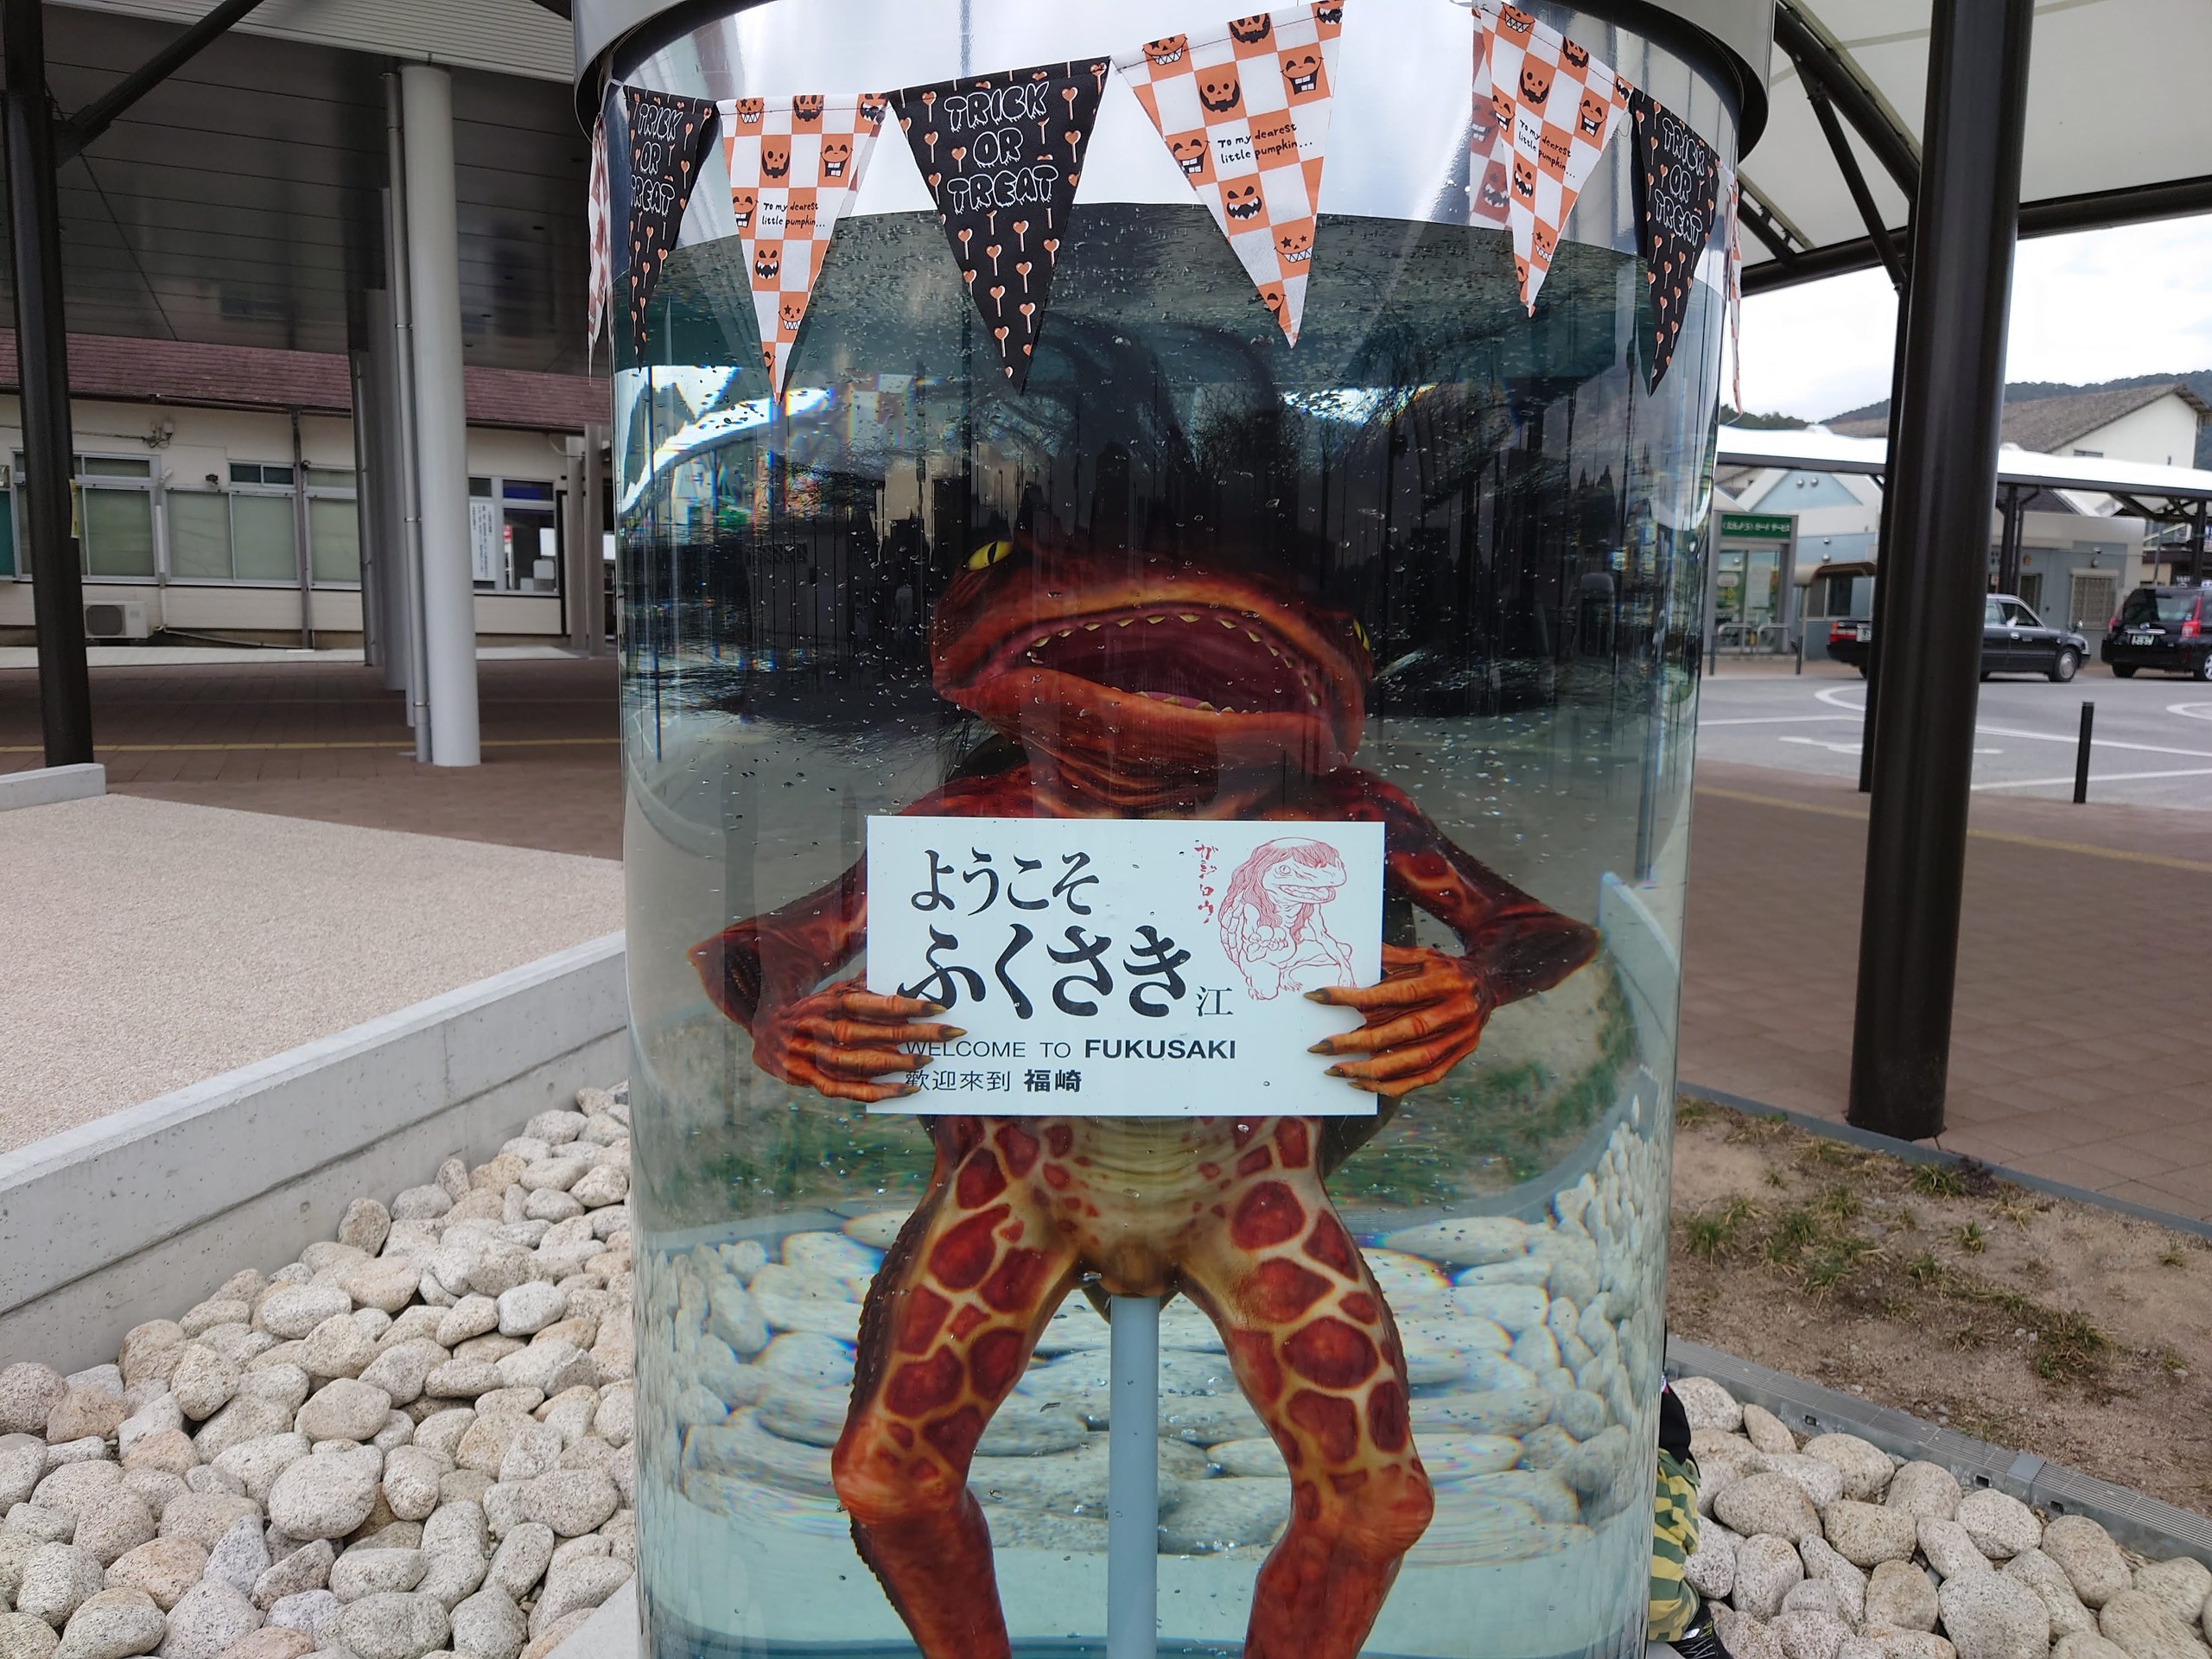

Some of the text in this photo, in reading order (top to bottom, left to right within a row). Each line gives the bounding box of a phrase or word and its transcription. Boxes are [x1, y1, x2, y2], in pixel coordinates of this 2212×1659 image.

[638, 103, 683, 142] TRICK
[944, 81, 1049, 132] TRICK
[973, 127, 1023, 168] OR
[1217, 124, 1297, 149] To my dearest
[1518, 131, 1537, 152] little
[1529, 129, 1541, 140] my
[1541, 136, 1571, 157] dearest
[1662, 118, 1705, 176] TRICK
[640, 141, 662, 175] OR
[1221, 149, 1251, 164] little
[630, 175, 675, 217] TREAT
[947, 164, 1058, 215] TREAT
[1669, 164, 1692, 204] OR
[761, 215, 784, 225] little
[763, 201, 819, 213] To my dearest
[1655, 188, 1703, 248] TREAT
[911, 846, 1100, 916] ようこそ
[906, 1039, 1236, 1059] WELCOME TO FUKUSAKI
[1023, 1068, 1082, 1093] 福崎
